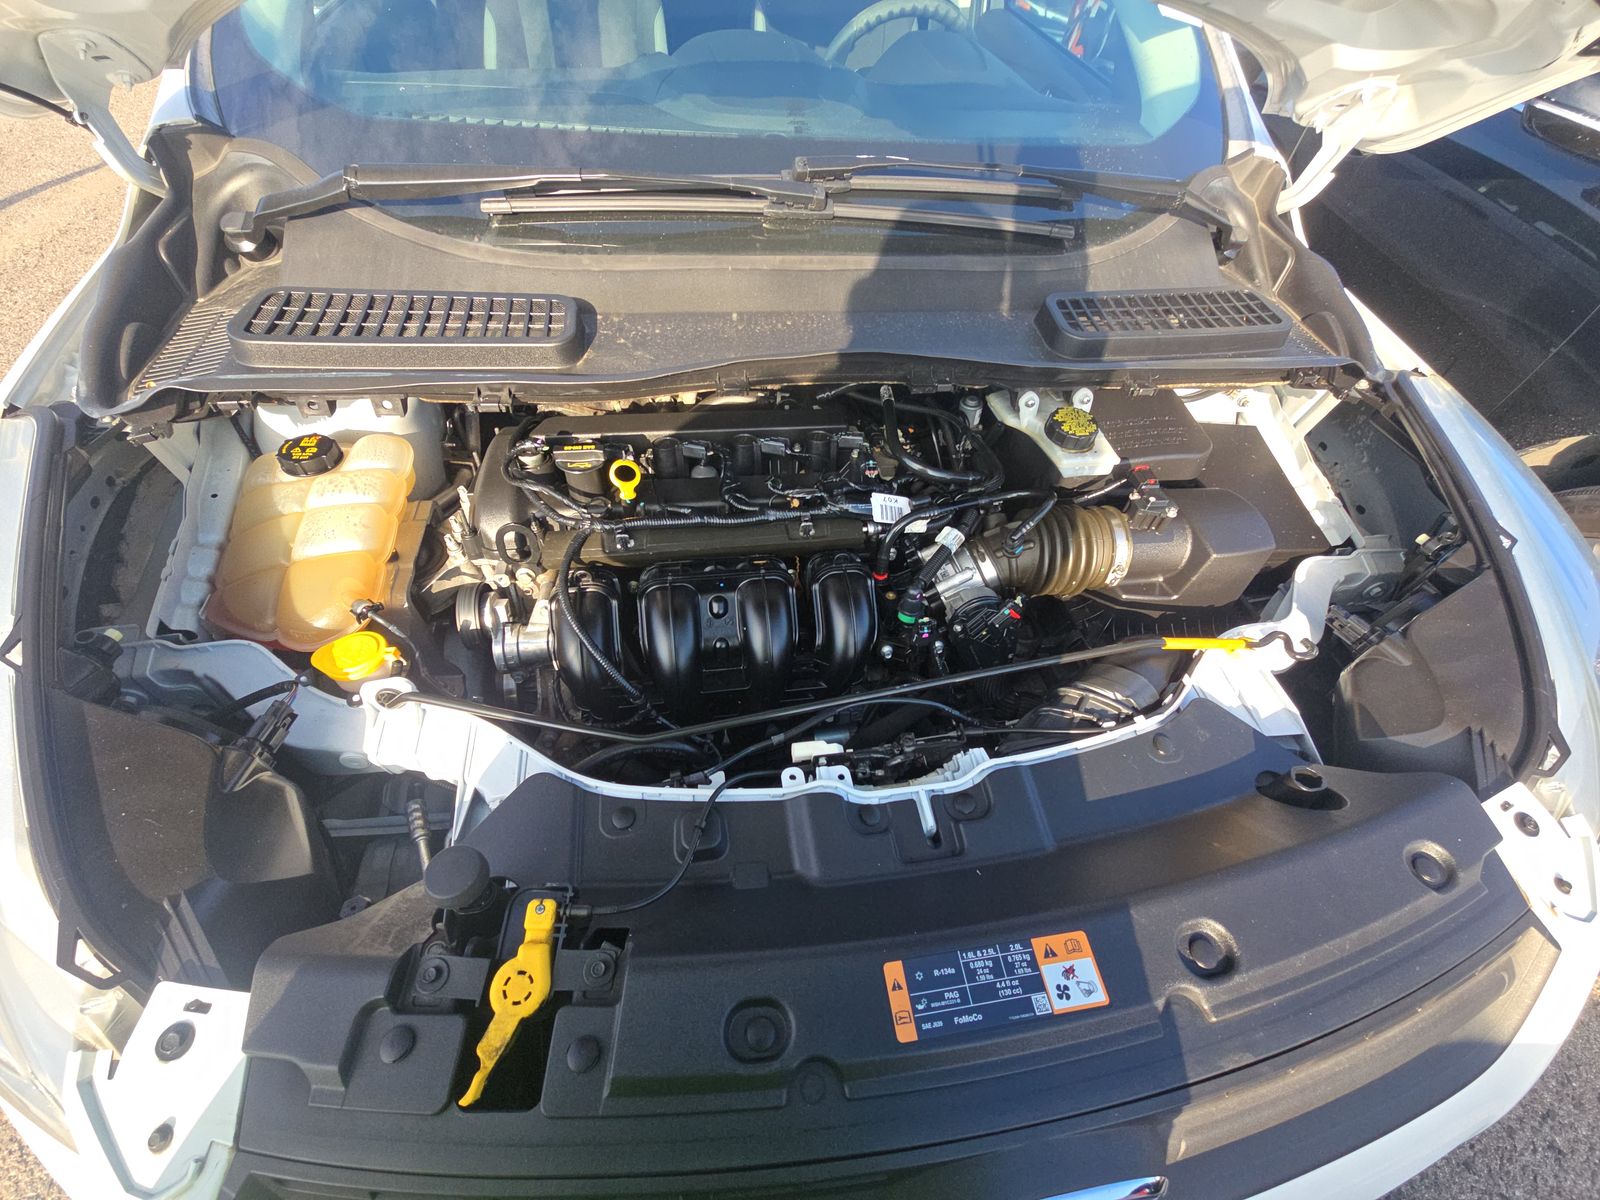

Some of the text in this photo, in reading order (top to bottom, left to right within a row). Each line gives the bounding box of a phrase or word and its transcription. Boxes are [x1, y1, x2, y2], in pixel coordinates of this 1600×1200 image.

[1022, 953, 1031, 961] kg
[934, 968, 956, 976] R-134a
[944, 990, 960, 999] PAG
[999, 987, 1023, 997] (130 cc)
[953, 1013, 983, 1025] FoMoCo
